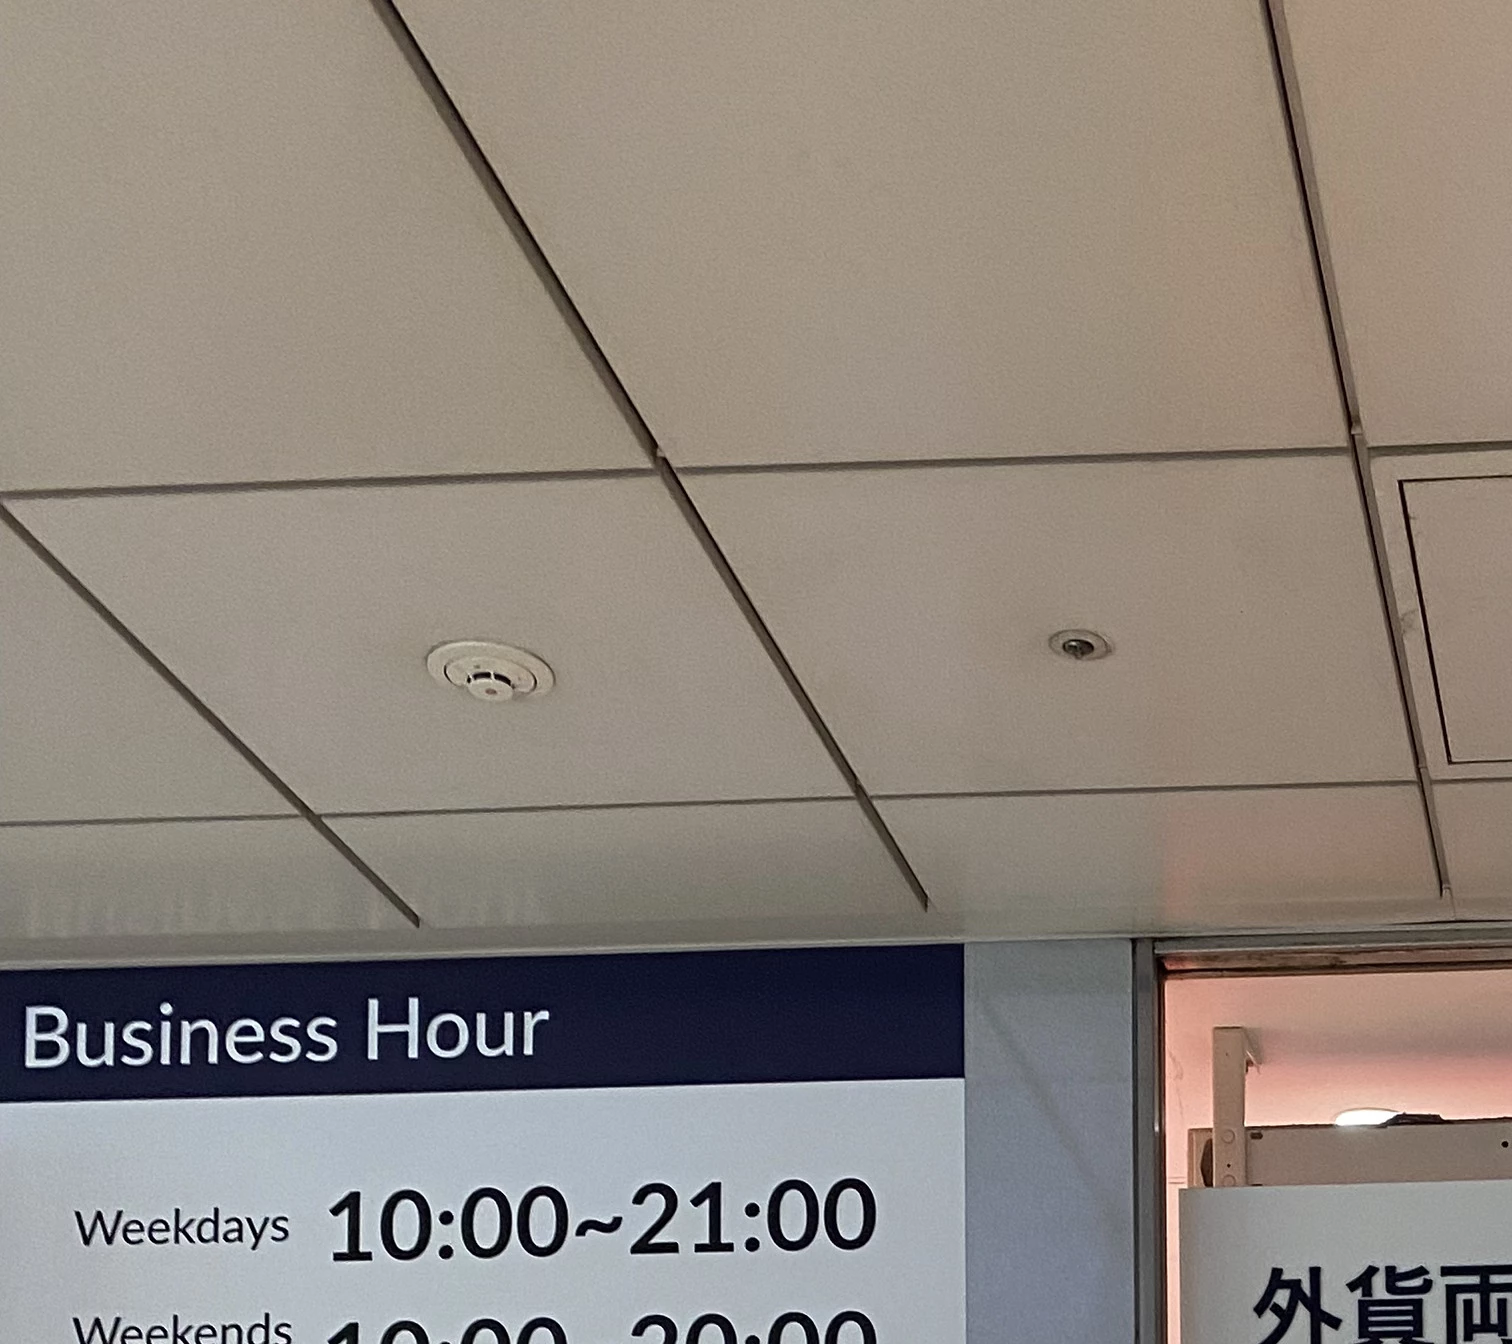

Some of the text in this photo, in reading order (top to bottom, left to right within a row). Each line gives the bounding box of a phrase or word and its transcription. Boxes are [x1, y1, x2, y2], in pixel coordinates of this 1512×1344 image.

[24, 996, 550, 1068] Business Hour
[74, 1177, 877, 1262] Weekdays 10:00~21:00
